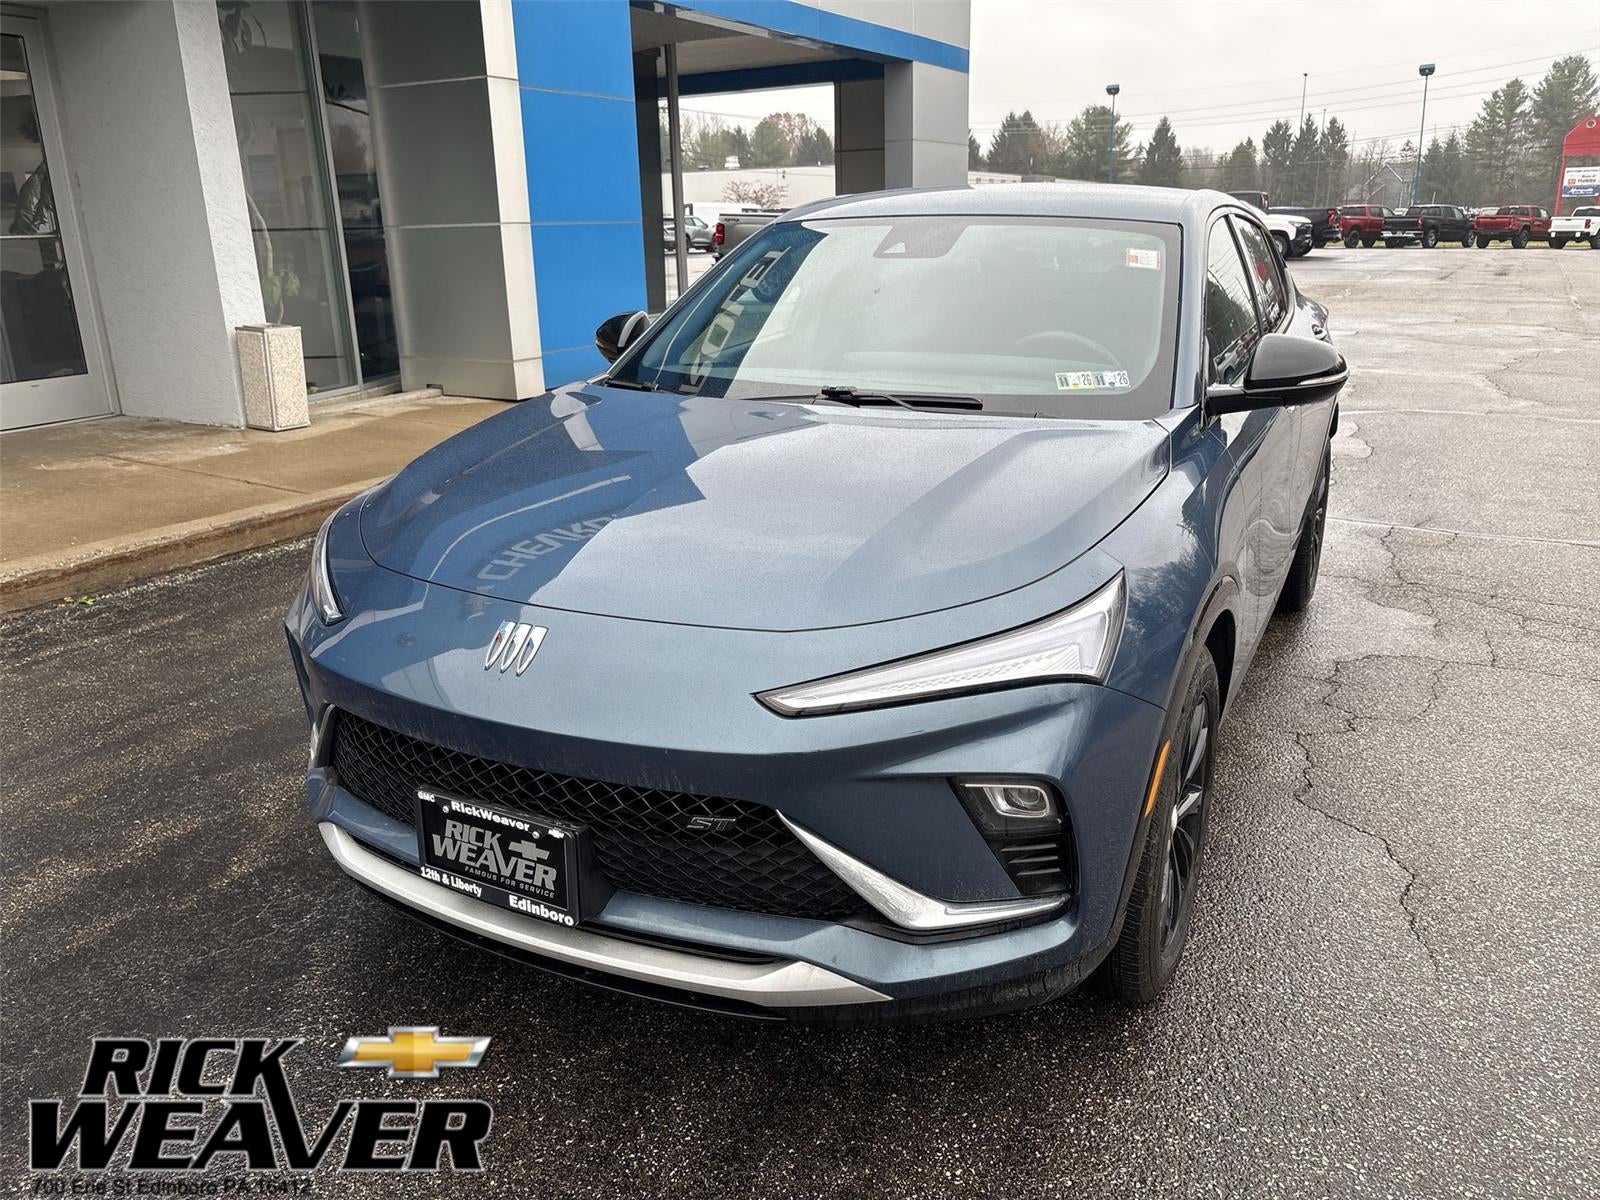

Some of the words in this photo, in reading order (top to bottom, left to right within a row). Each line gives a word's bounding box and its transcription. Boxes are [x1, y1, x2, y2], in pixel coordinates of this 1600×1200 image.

[1081, 373, 1092, 386] 26
[1117, 372, 1128, 385] 26
[417, 791, 436, 802] GMC
[450, 800, 530, 832] RickWeaver
[686, 816, 736, 831] ST
[444, 819, 502, 849] RICK
[432, 833, 557, 890] WEAVER
[420, 866, 441, 883] 12th
[441, 874, 450, 886] &
[450, 876, 482, 897] Liberty
[464, 865, 497, 881] FAMOUS
[500, 877, 516, 887] FOR
[519, 882, 555, 899] SERVICE
[508, 894, 575, 927] Edinboro
